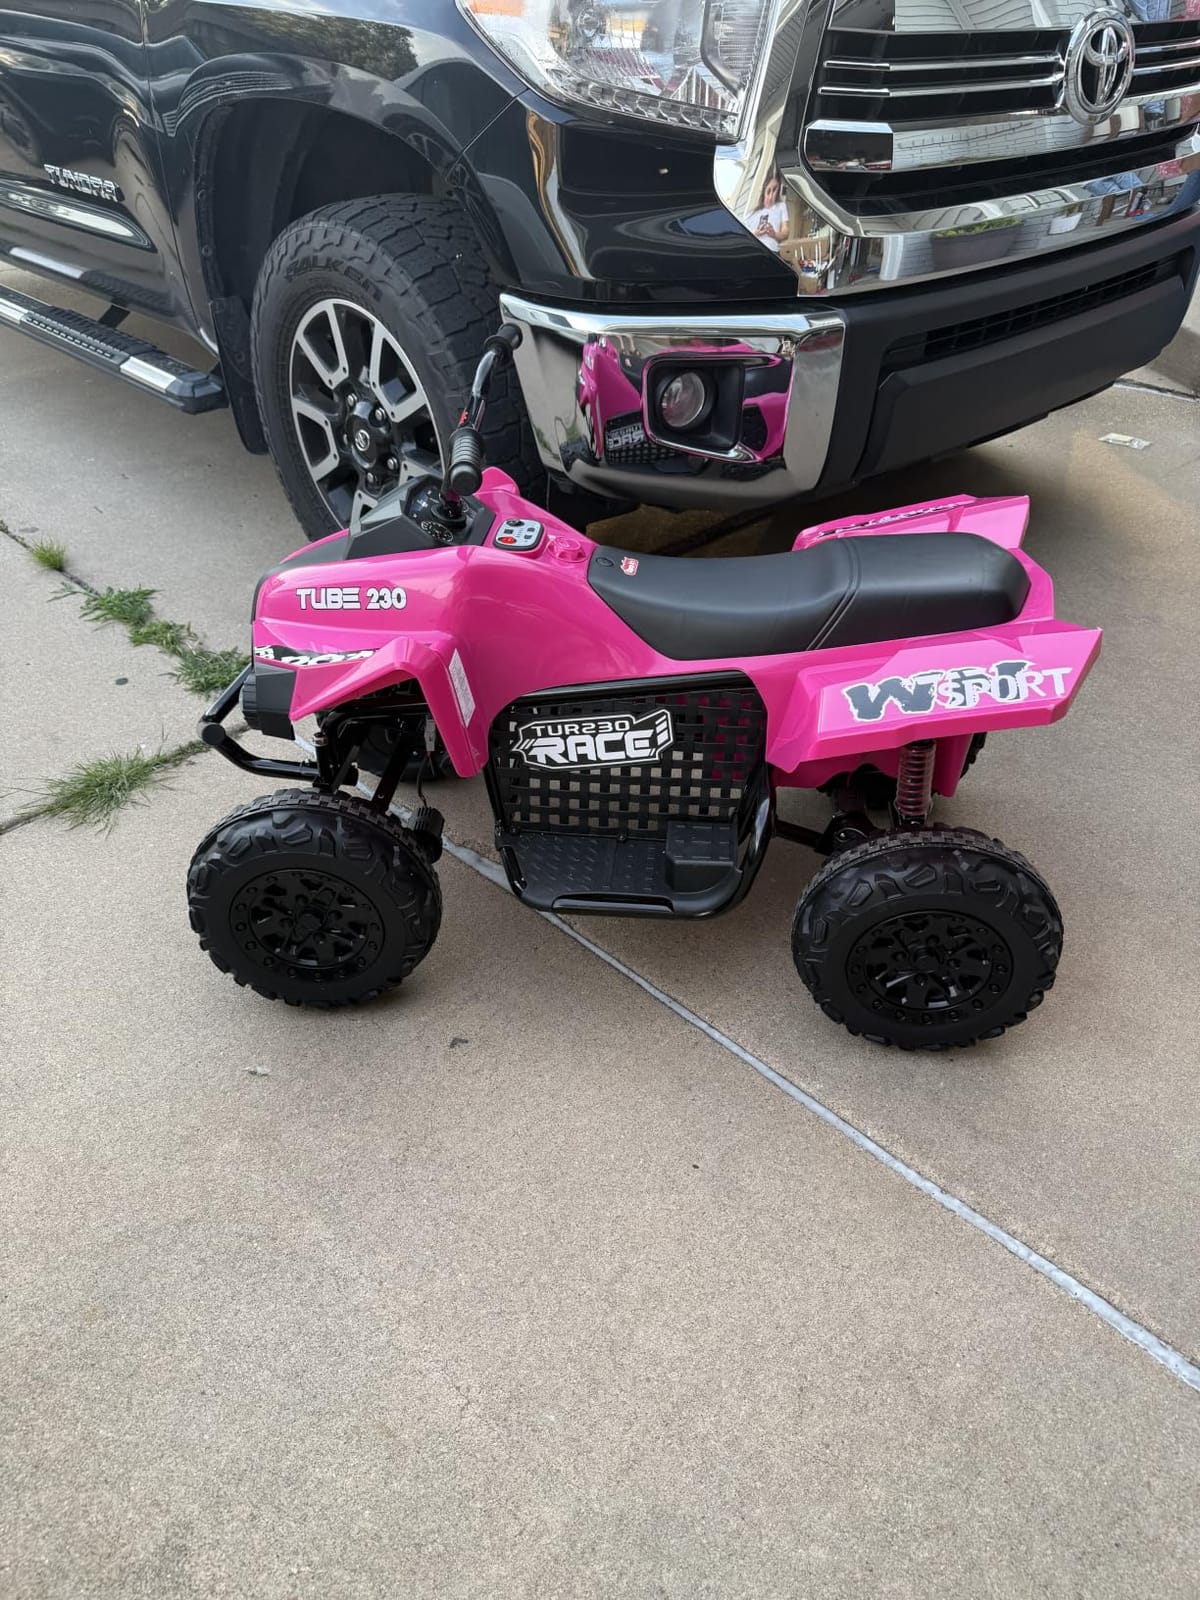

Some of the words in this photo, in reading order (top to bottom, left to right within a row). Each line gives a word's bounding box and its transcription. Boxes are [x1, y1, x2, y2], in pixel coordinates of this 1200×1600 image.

[43, 163, 118, 203] TUNDRA
[296, 587, 361, 610] TUBE
[365, 587, 407, 610] 230
[528, 729, 654, 764] RACE
